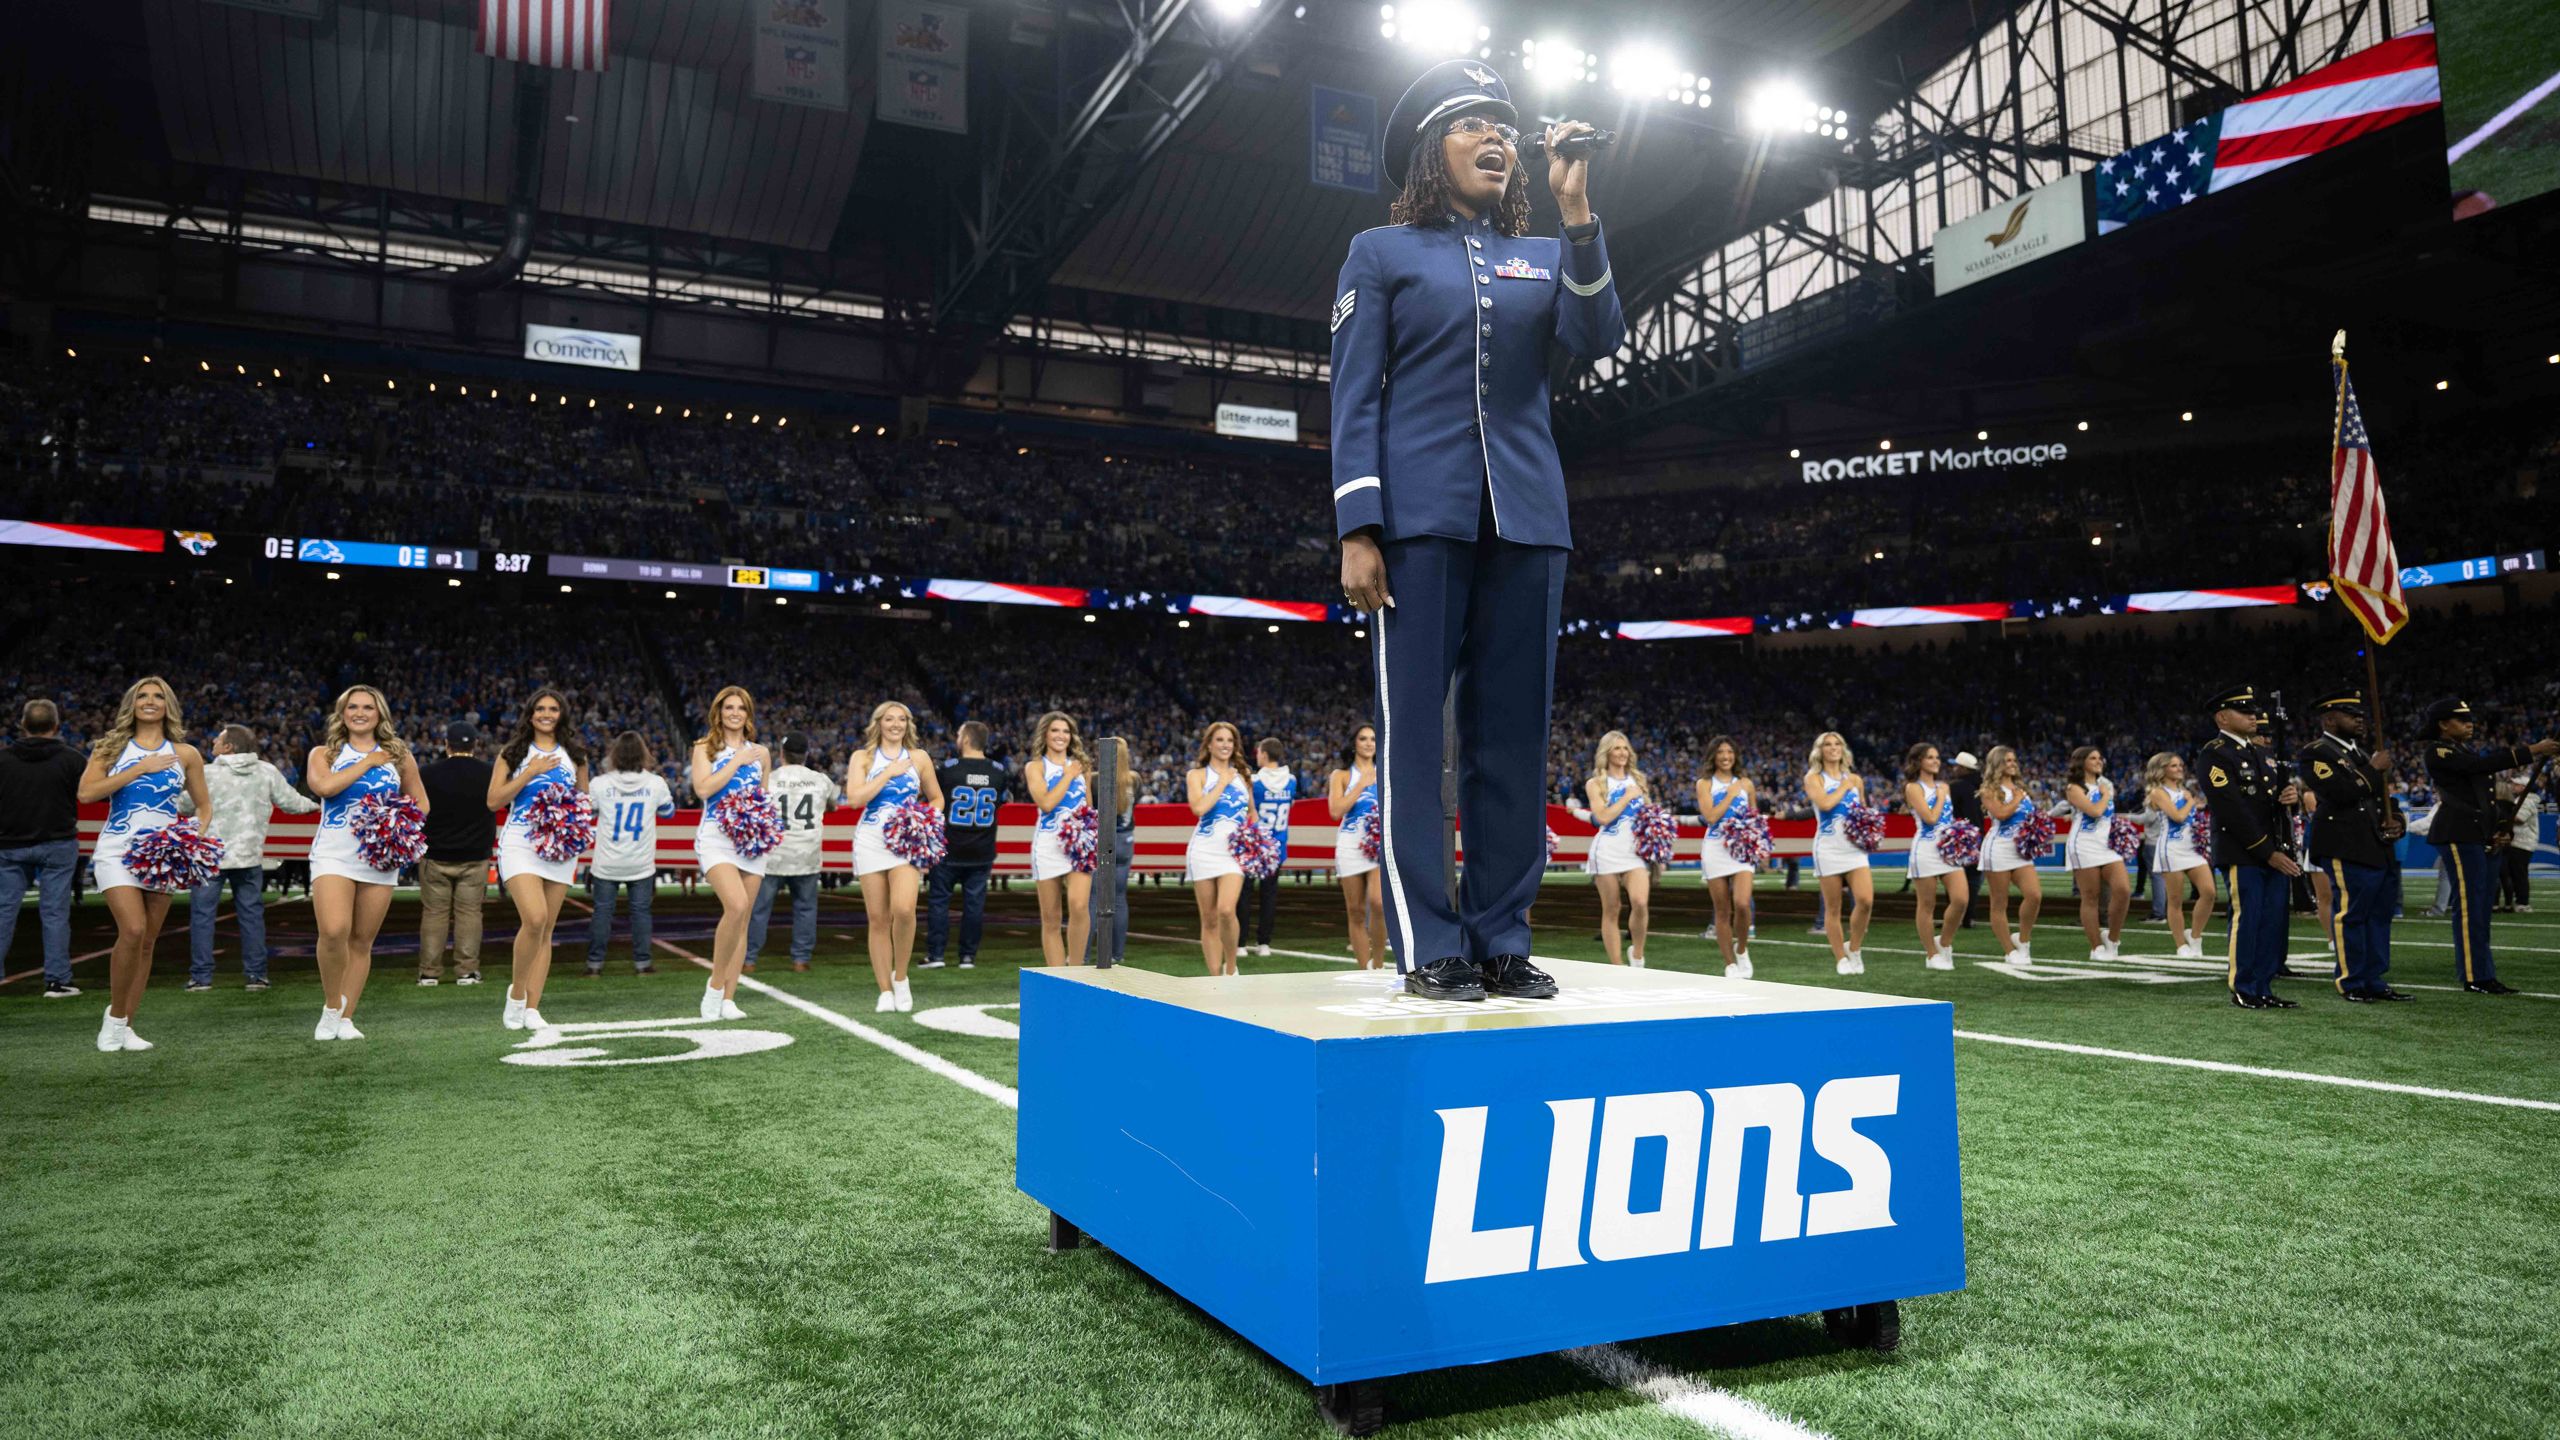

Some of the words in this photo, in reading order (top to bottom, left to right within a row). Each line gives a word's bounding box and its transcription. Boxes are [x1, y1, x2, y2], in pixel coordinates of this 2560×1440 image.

[2014, 233, 2049, 255] EAGLE
[1802, 450, 1924, 483] ROCKET
[265, 537, 279, 559] 0
[398, 546, 412, 567] 0
[453, 551, 464, 569] 1
[494, 553, 531, 573] 3:37
[2462, 561, 2474, 579] 0
[2525, 552, 2536, 570] 1
[737, 570, 761, 584] 25
[966, 773, 990, 786] GIBBS
[777, 793, 816, 831] 14
[949, 785, 997, 827] 26
[1258, 802, 1291, 831] 58
[612, 802, 645, 841] 14
